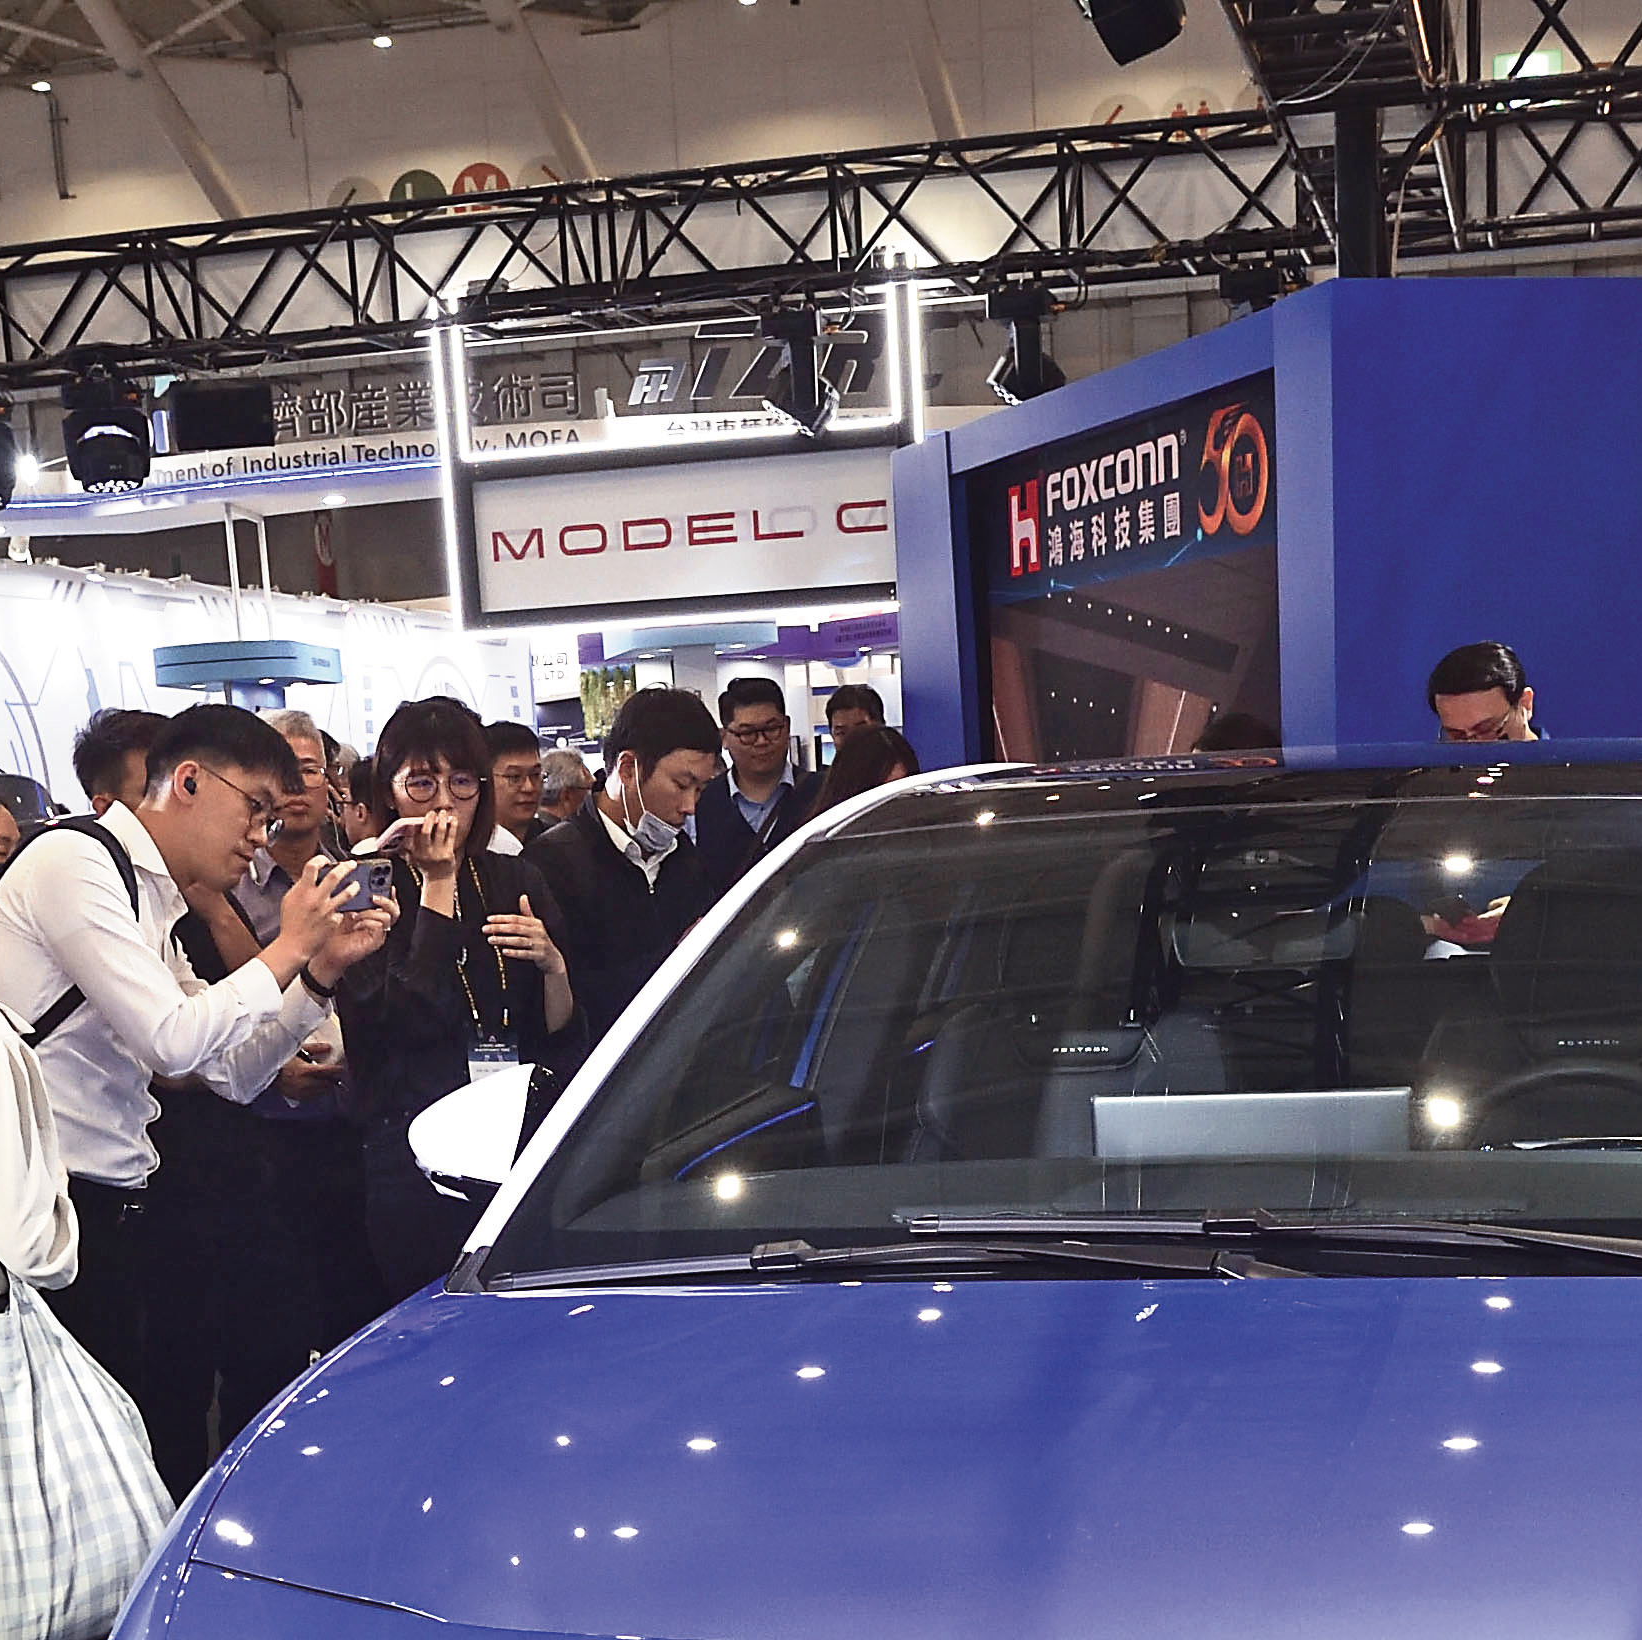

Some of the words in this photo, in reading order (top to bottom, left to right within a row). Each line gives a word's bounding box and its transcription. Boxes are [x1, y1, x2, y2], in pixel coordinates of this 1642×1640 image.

[212, 456, 233, 477] of
[243, 442, 347, 473] Industrial
[491, 510, 805, 562] MODEL
[836, 499, 888, 534] C
[1047, 491, 1181, 568] 鴻海科技集團
